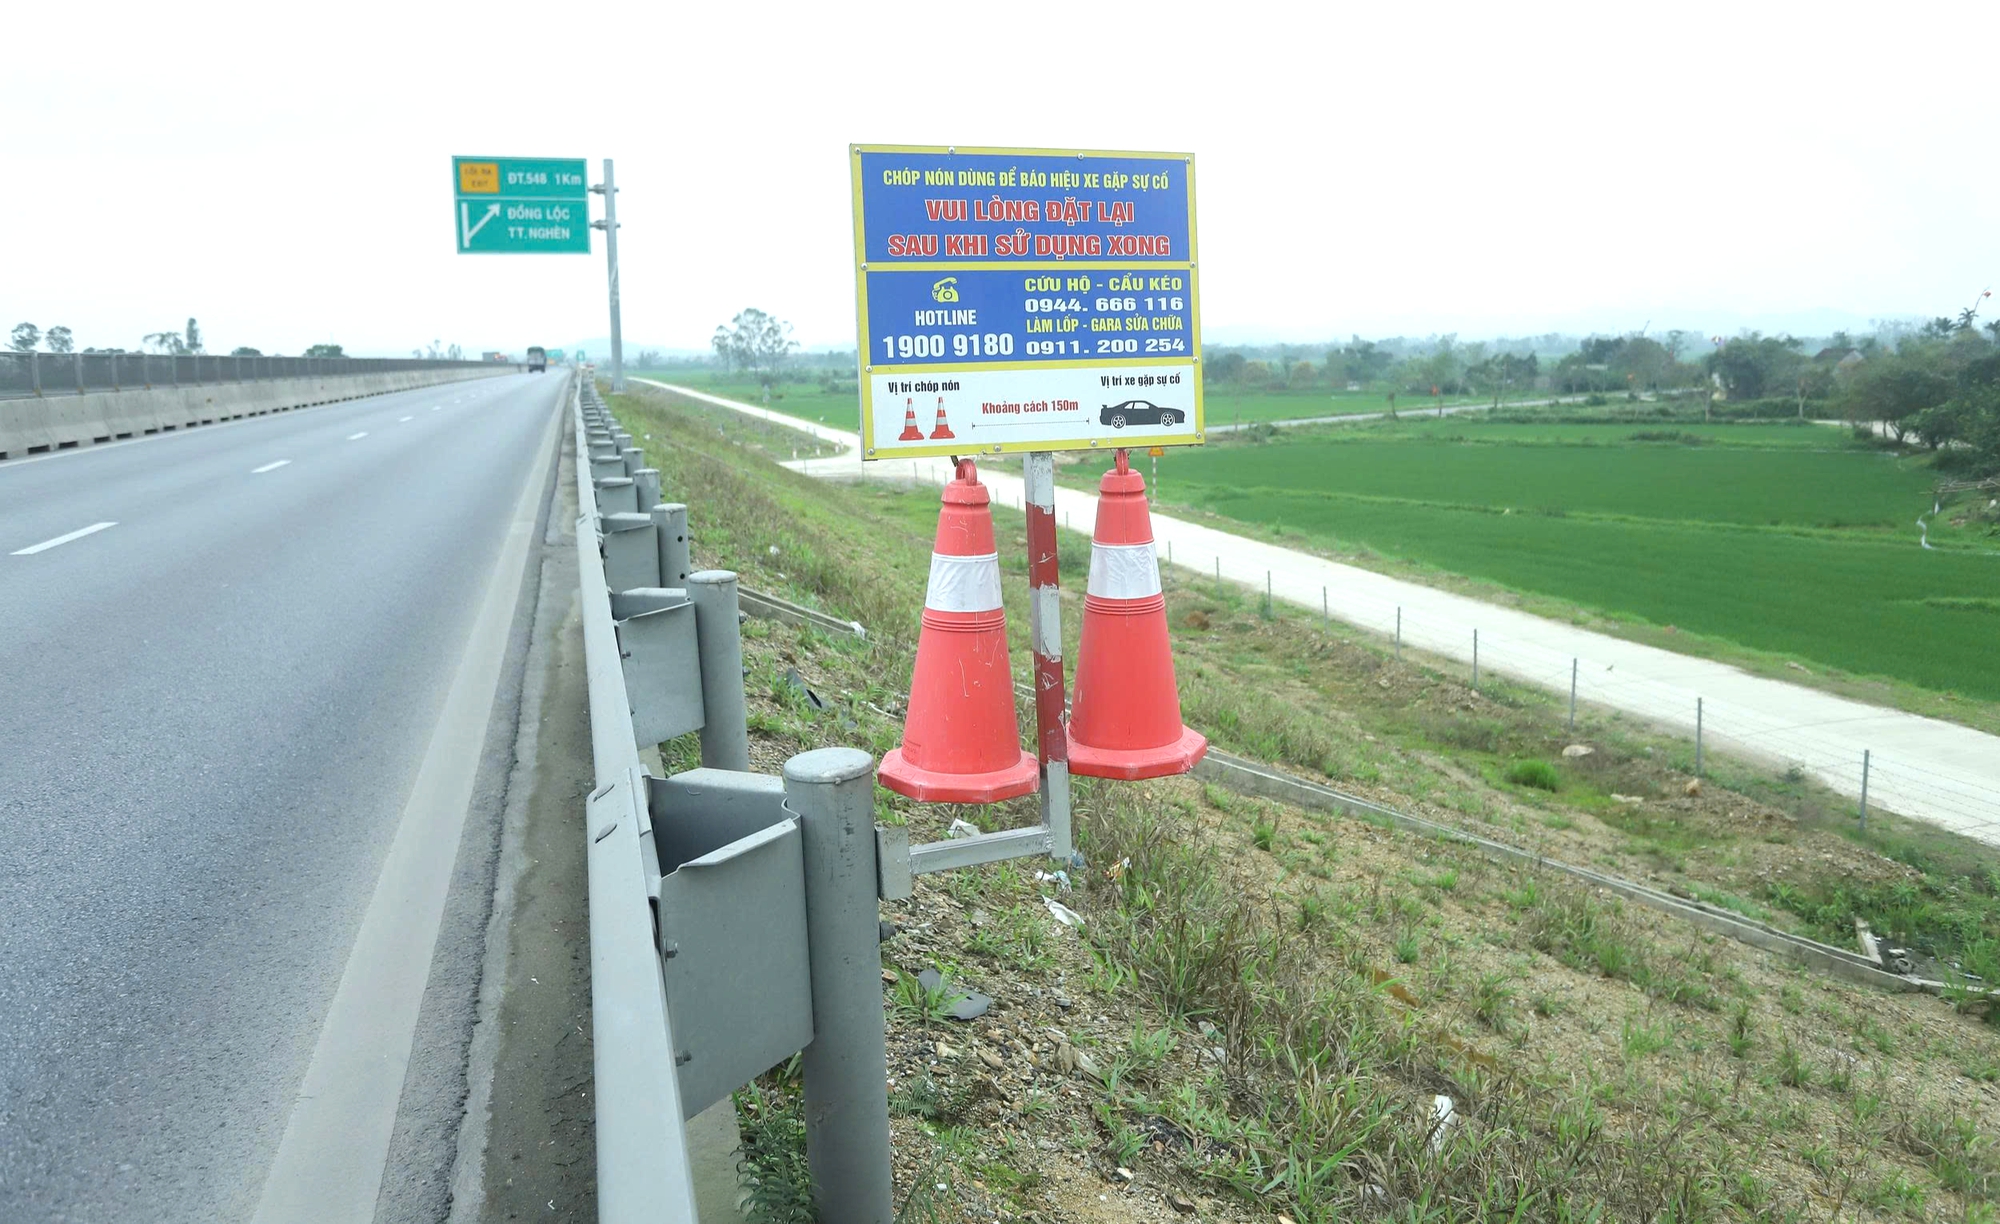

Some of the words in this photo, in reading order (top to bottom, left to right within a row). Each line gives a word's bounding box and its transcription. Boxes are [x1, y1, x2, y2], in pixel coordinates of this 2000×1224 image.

[883, 168, 920, 186] CHÓP
[924, 168, 954, 186] NÓN
[958, 168, 996, 186] DÙNG
[999, 166, 1016, 187] ĐỂ
[1020, 170, 1046, 187] BÁO
[1050, 170, 1080, 190] HIỆU
[1084, 174, 1100, 188] XE
[1103, 171, 1128, 192] GẶP
[1132, 173, 1150, 192] SỰ
[1152, 170, 1168, 190] CỐ
[546, 205, 570, 222] LỘC
[926, 198, 967, 220] VUI
[974, 195, 1040, 222] LÒNG
[1044, 196, 1092, 226] ĐẶT
[1097, 202, 1134, 226] LẠI
[888, 235, 938, 256] SAU
[946, 235, 987, 256] KHI
[995, 228, 1030, 256] SỬ
[1036, 235, 1100, 260] DỤNG
[1107, 235, 1170, 256] XONG
[1024, 276, 1060, 292] CỨU
[1067, 276, 1090, 294] HỘ
[1109, 273, 1144, 291] CẨU
[1150, 275, 1182, 291] KÉO
[1025, 298, 1088, 312] 0944.
[1096, 298, 1136, 312] 666
[1144, 297, 1184, 310] 116
[915, 310, 976, 326] HOTLINE
[1026, 316, 1052, 333] LÀM
[1056, 314, 1078, 332] LỐP
[1091, 318, 1122, 332] GARA
[1126, 313, 1148, 331] SỬA
[1152, 315, 1182, 330] CHỮA
[882, 334, 945, 358] 1900
[953, 332, 1014, 356] 9180
[1026, 340, 1090, 354] 0911.
[1097, 340, 1138, 353] 200
[1145, 338, 1185, 352] 254
[888, 382, 898, 395] Vị
[901, 382, 911, 392] trí
[915, 380, 938, 393] chóp
[942, 380, 960, 392] nón
[1100, 376, 1110, 388] Vị
[1112, 375, 1122, 386] trí
[1124, 376, 1136, 386] xe
[1138, 374, 1154, 388] gặp
[1156, 375, 1168, 386] sự
[1170, 372, 1181, 384] cố
[982, 401, 1020, 414] Khoảng
[1024, 400, 1048, 412] cách
[1052, 400, 1078, 412] 150m
